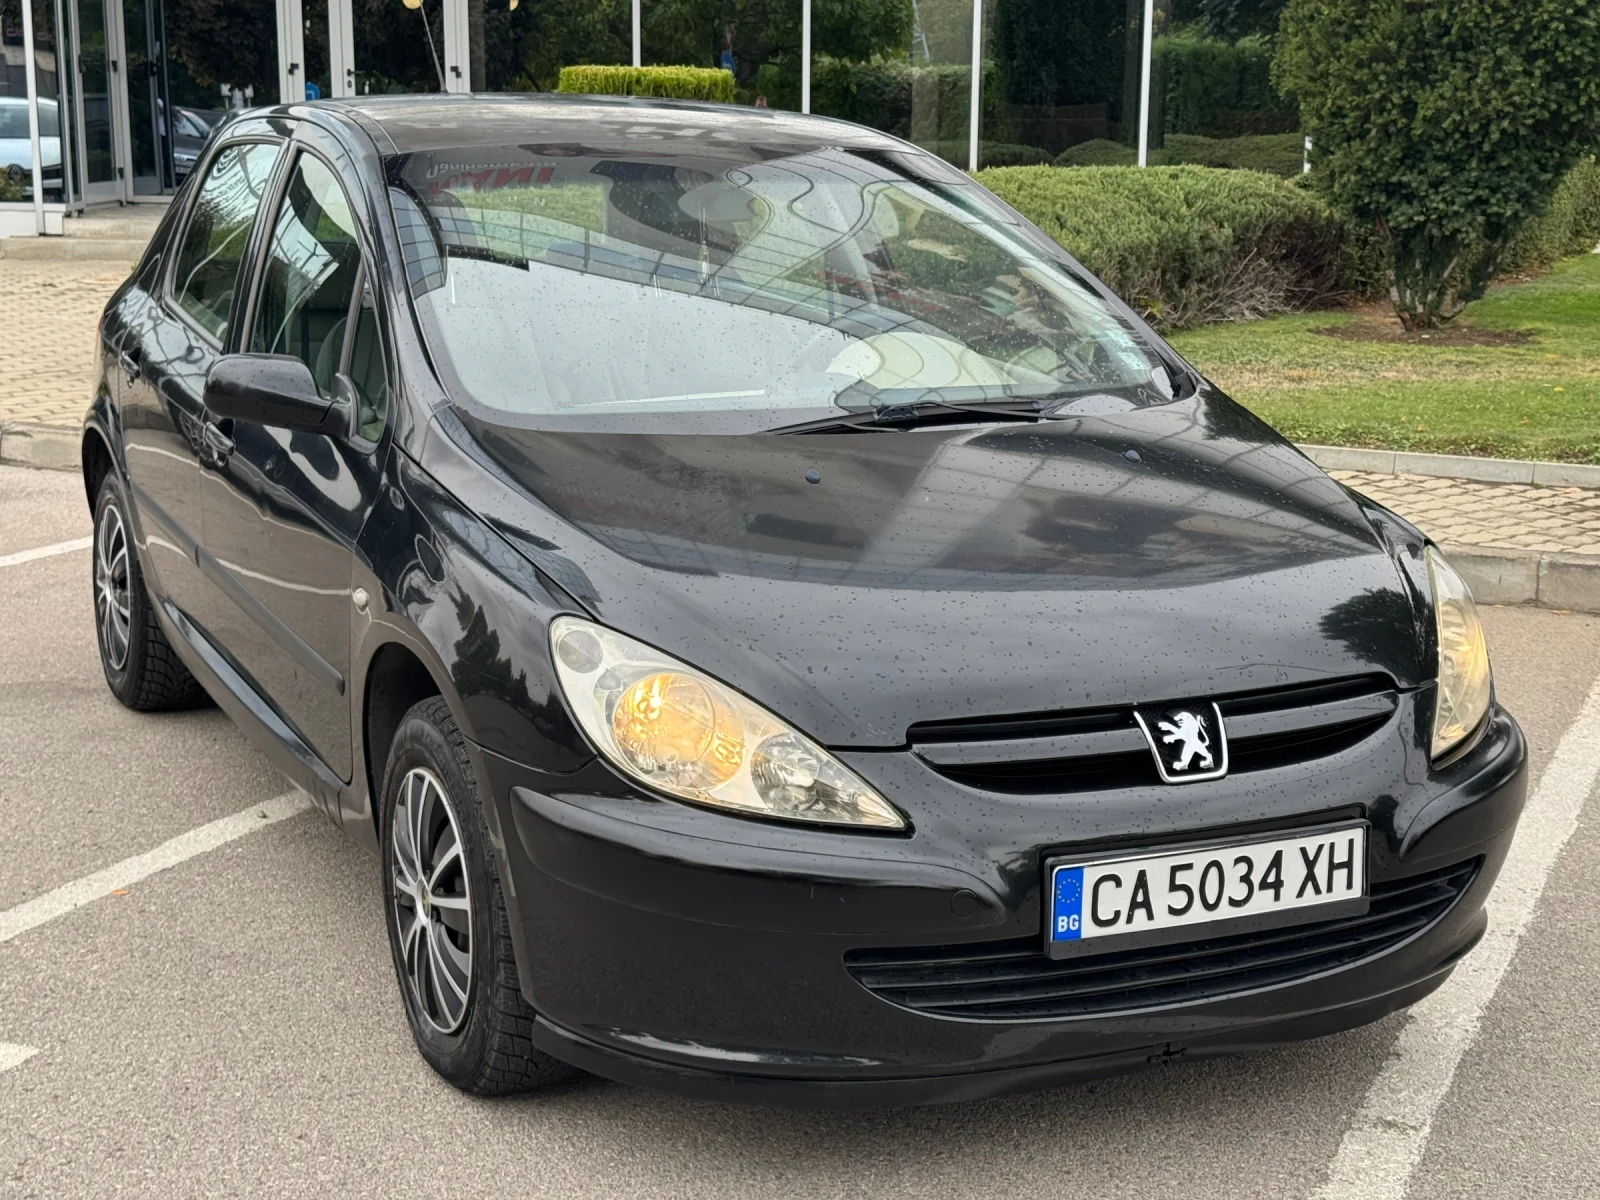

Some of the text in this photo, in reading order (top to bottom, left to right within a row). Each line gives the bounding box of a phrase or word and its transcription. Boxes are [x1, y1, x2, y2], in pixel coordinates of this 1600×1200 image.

[1091, 838, 1355, 928] CA 5034 XH
[1057, 914, 1079, 933] BG
